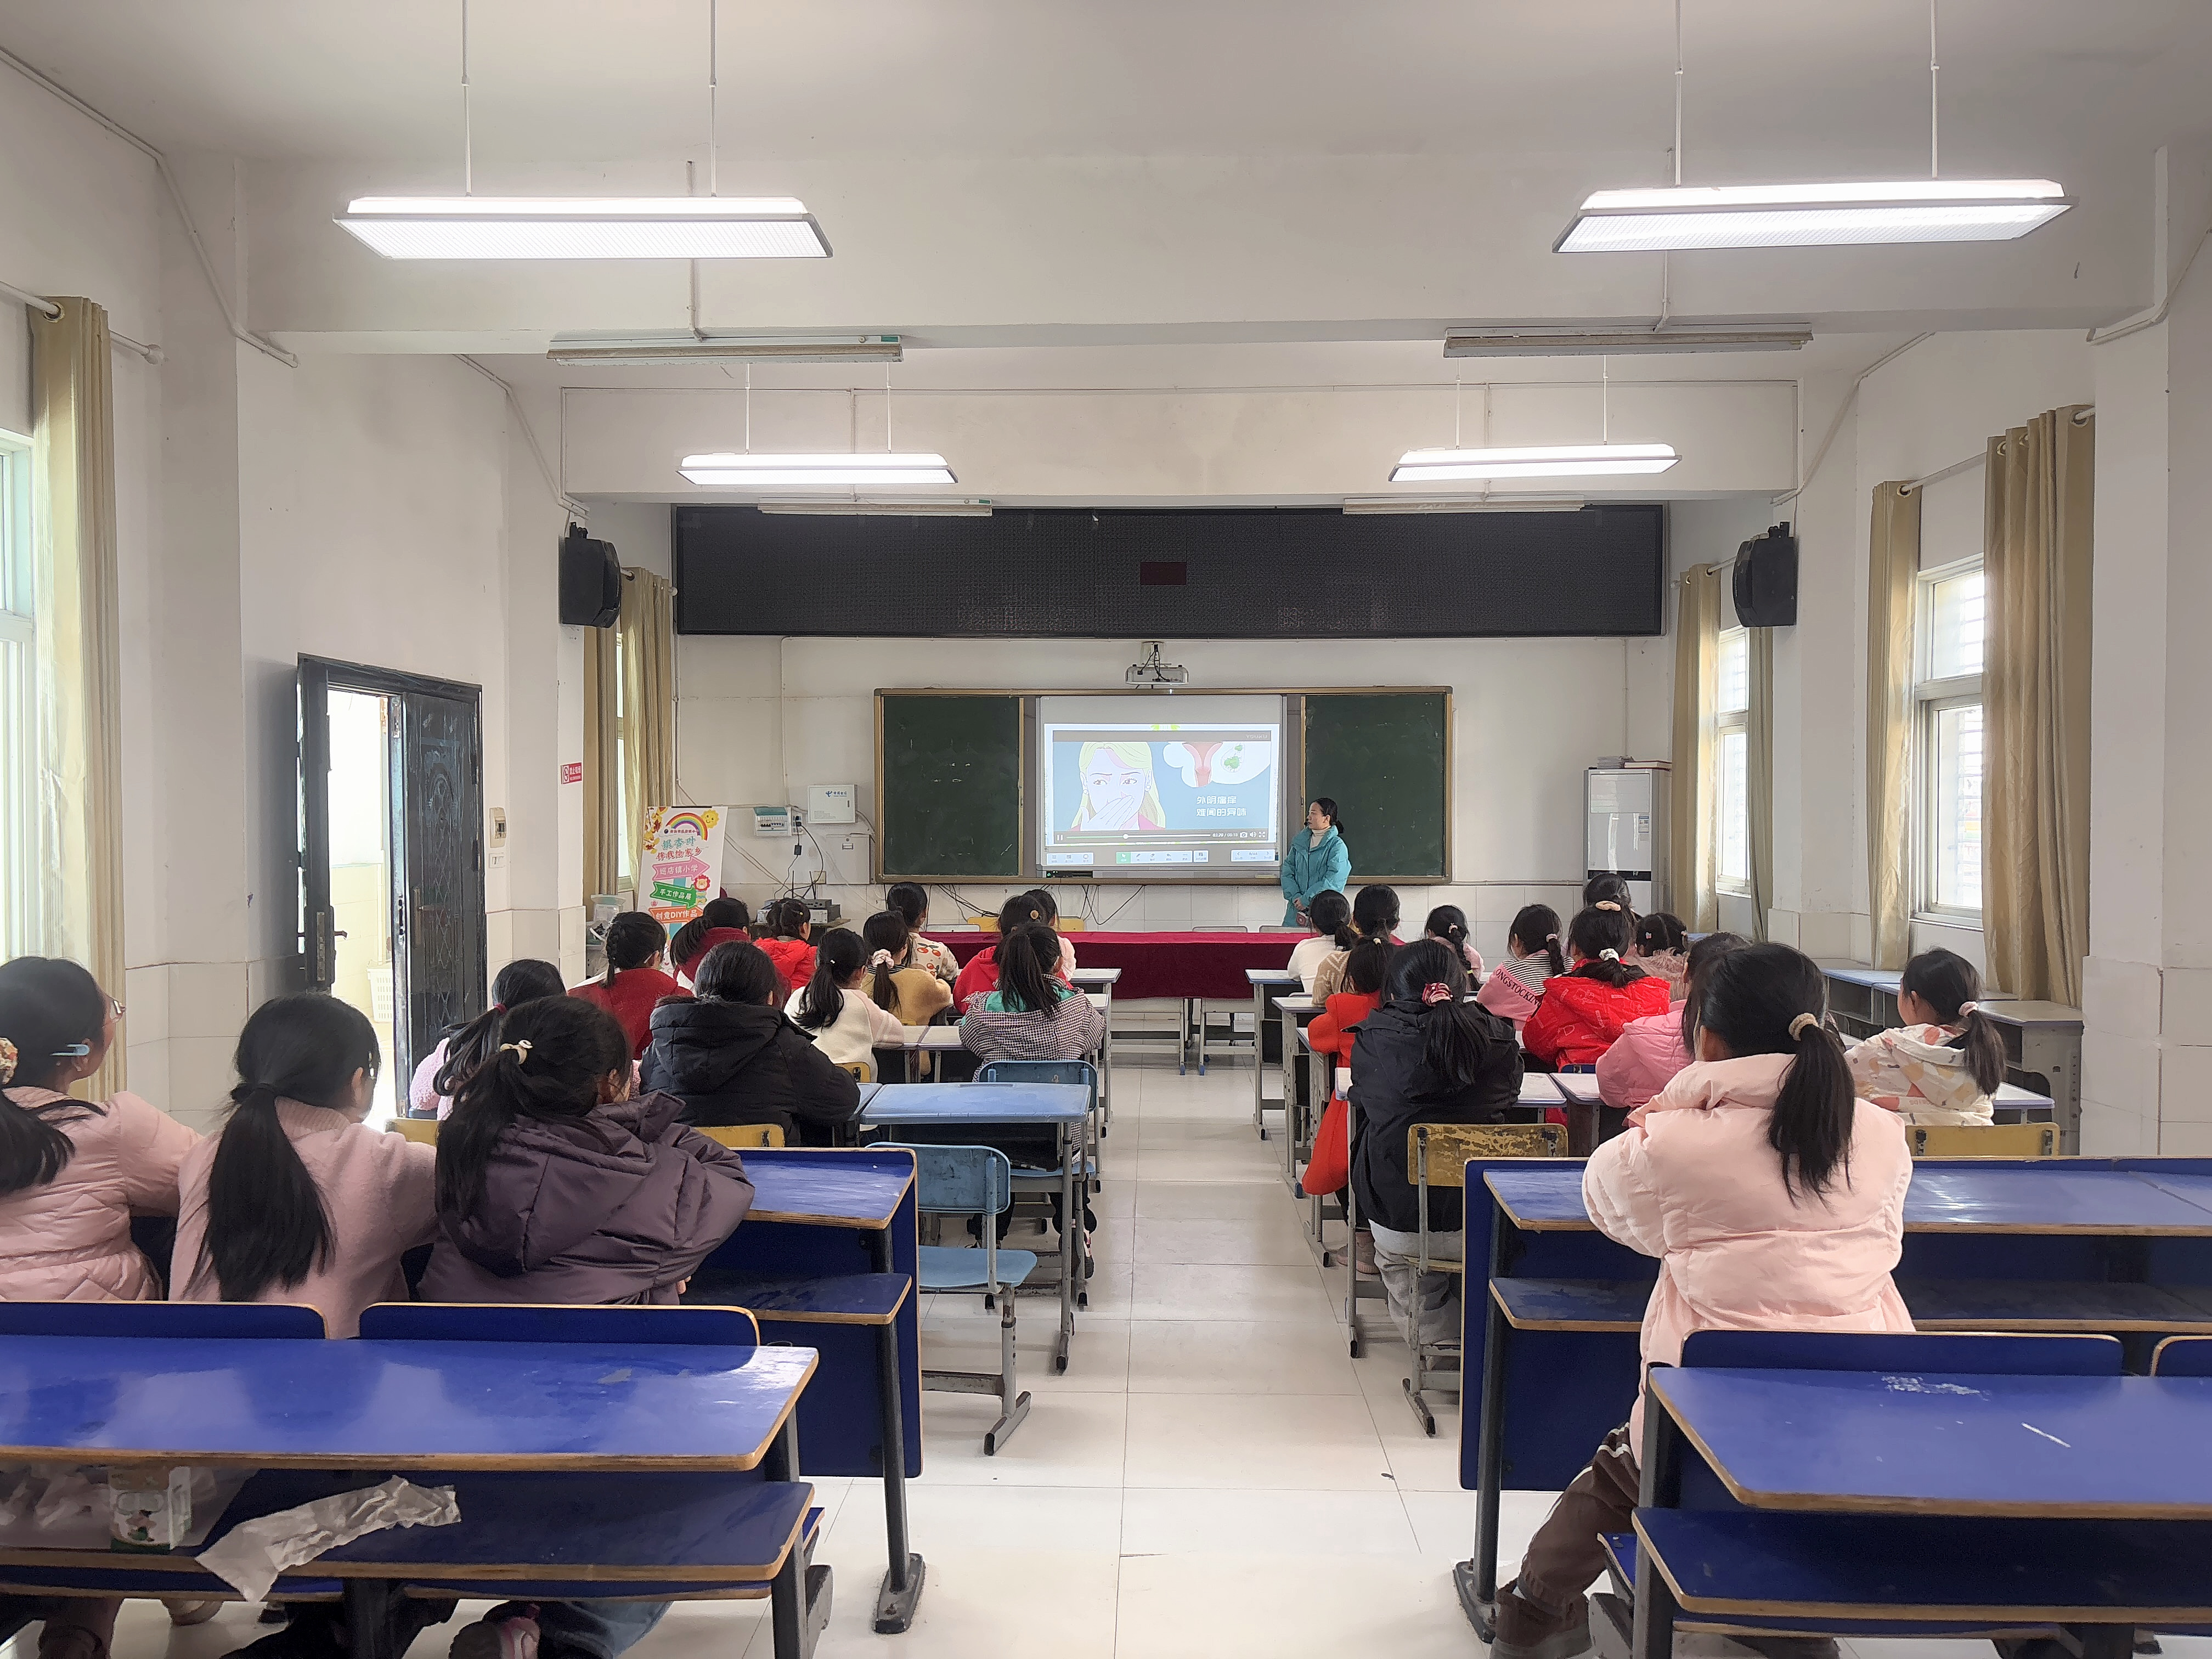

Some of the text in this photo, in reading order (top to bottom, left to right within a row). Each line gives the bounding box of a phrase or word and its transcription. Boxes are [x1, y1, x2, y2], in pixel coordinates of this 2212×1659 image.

[1197, 795, 1237, 804] 外阴瘙痒
[1196, 808, 1247, 816] 难闻的异味
[662, 836, 696, 850] 银杏叶
[660, 864, 698, 875] 巡店镇小学
[660, 889, 691, 900] 手工作品展
[656, 910, 697, 919] 创意DIY作品
